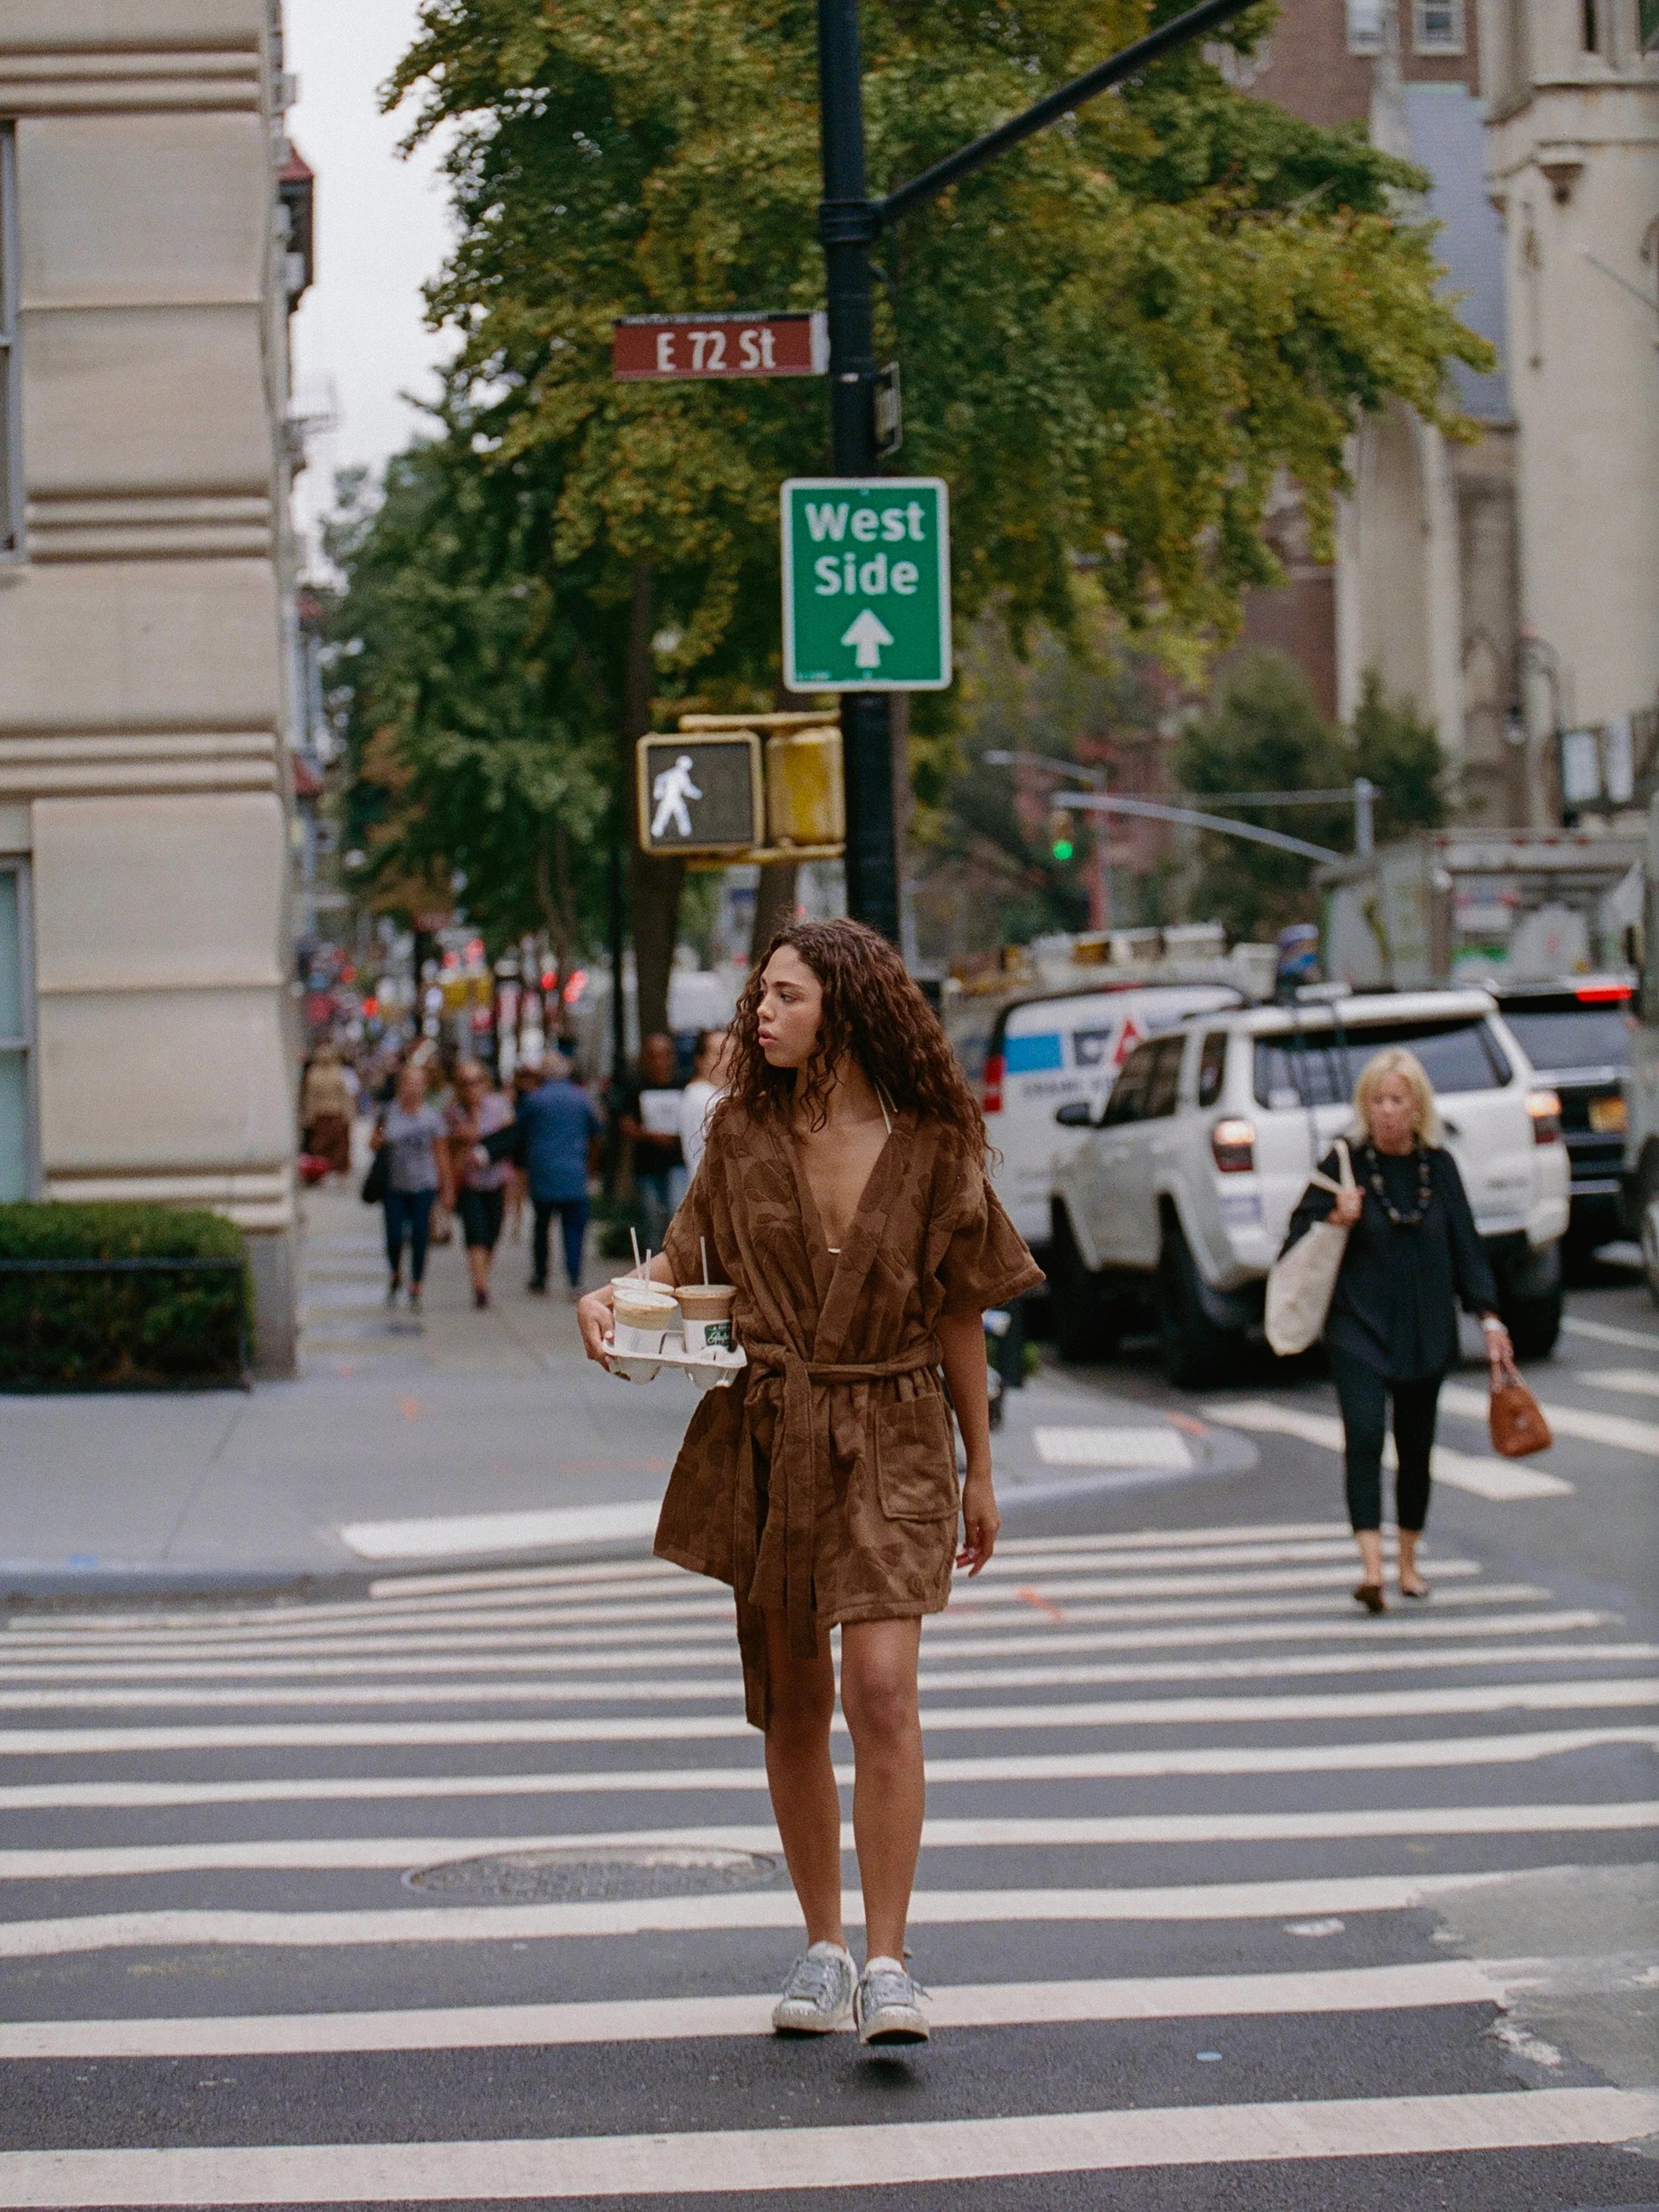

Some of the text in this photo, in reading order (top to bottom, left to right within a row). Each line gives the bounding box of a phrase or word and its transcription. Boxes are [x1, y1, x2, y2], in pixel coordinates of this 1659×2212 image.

[656, 328, 776, 372] E 72 St
[805, 501, 925, 542] West
[814, 551, 919, 596] Side
